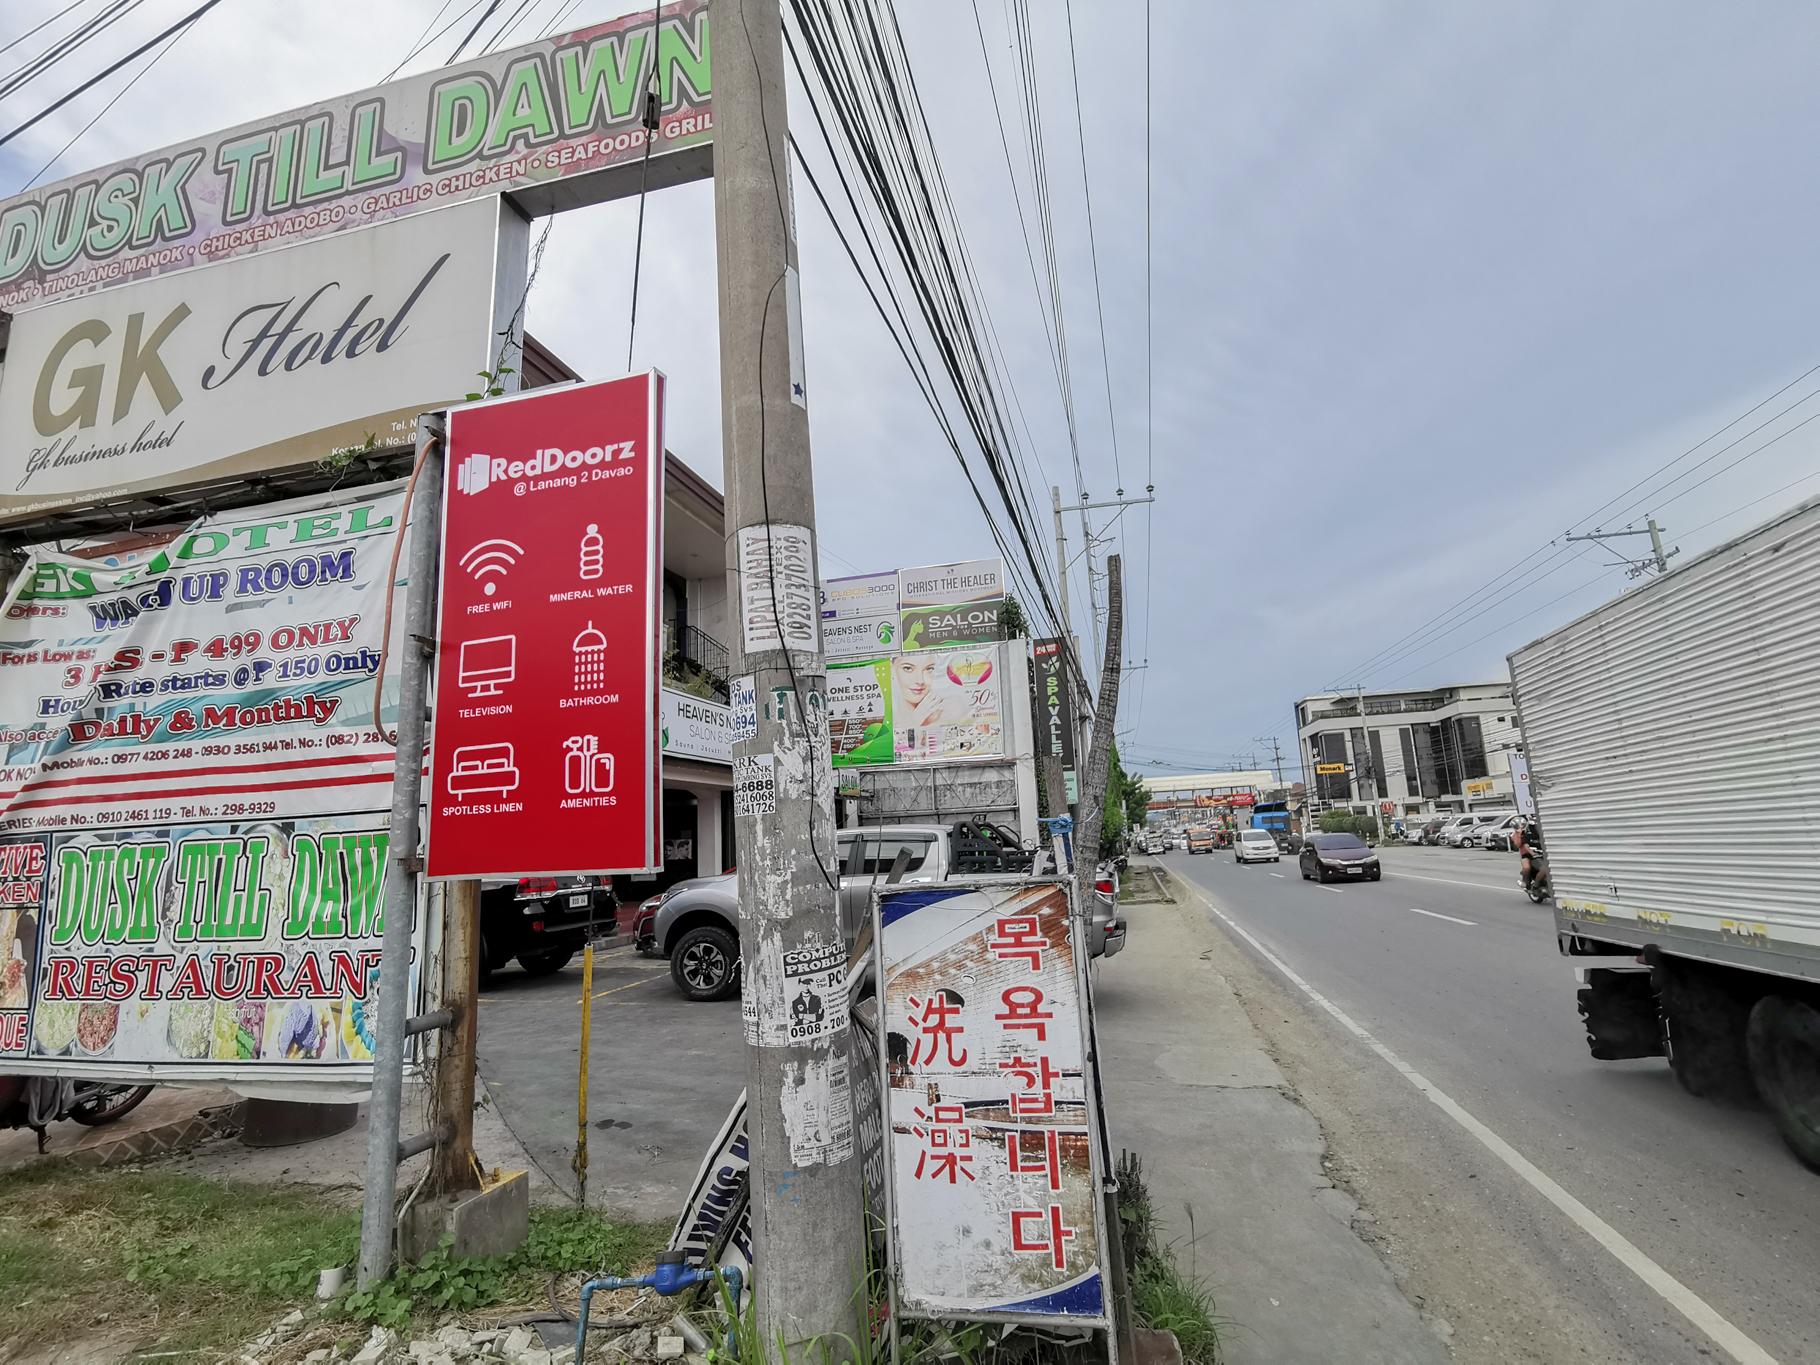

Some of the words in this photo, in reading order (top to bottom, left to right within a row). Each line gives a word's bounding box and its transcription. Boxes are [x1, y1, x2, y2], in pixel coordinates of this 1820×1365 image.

[1, 152, 199, 275] DUSK
[218, 101, 400, 220] TILL
[431, 12, 711, 165] DAWN
[42, 263, 120, 296] TINOLANG
[123, 246, 185, 275] MANOK
[199, 223, 278, 256] CHICKEN
[281, 205, 345, 236] ADOBO
[362, 183, 433, 214] GARLIC
[436, 159, 527, 197] CHICKEN
[546, 130, 659, 168] SEAFOODS
[665, 114, 713, 138] GRIL
[32, 302, 193, 438] GK
[201, 253, 451, 391] Hotel
[392, 420, 407, 431] Tel.
[386, 436, 404, 446] No.:
[16, 436, 53, 491] Gk
[53, 432, 127, 470] business
[130, 420, 184, 461] hotel
[491, 440, 636, 482] RedDoorz
[514, 482, 527, 496] @
[530, 475, 577, 491] Lanang
[581, 472, 588, 483] 2
[592, 466, 633, 481] Davao
[746, 536, 775, 592] BAHAY
[775, 536, 784, 578] TEXT
[180, 571, 229, 604] UP
[236, 549, 356, 596] ROOM
[907, 580, 939, 594] CHRIST
[940, 577, 958, 590] THE
[961, 573, 996, 588] HEALER
[550, 589, 594, 602] MINERAL
[596, 584, 633, 597] WATER
[467, 604, 490, 614] FREE
[493, 601, 512, 611] WIFI
[748, 594, 778, 641] LIPAT
[777, 595, 786, 638] CALL
[929, 610, 997, 628] SALON
[823, 625, 852, 637] EAVEN'S
[854, 624, 872, 634] NEST
[852, 635, 863, 643] SPA
[963, 626, 998, 635] WOMEN
[63, 664, 83, 688] 3
[270, 614, 360, 651] ONLY
[158, 671, 226, 694] starts
[277, 656, 319, 681] 150
[324, 649, 382, 681] Only
[560, 694, 619, 708] BATHROOM
[734, 690, 754, 708] TANK
[830, 686, 850, 695] ONE
[853, 684, 879, 693] STOP
[68, 710, 162, 744] Daily
[169, 710, 197, 736] &
[202, 696, 339, 730] Monthly
[459, 705, 512, 718] TELEVISION
[677, 701, 724, 727] HEAVEN'S
[690, 724, 715, 740] SALON
[111, 752, 139, 765] 0977
[143, 749, 170, 761] 4206
[172, 747, 192, 760] 248
[201, 744, 230, 756] 0930
[234, 743, 260, 755] 3561
[262, 740, 278, 752] 944
[279, 738, 297, 751] Tel.
[298, 736, 323, 748] No.:
[326, 733, 359, 749] (082)
[745, 765, 772, 775] TANK
[70, 812, 93, 825] No.:
[97, 811, 122, 823] 0910
[124, 809, 149, 821] 2461
[152, 807, 171, 820] 119
[180, 805, 196, 818] Tel.
[199, 805, 218, 816] No.:
[222, 801, 275, 816] 298-9329
[442, 804, 491, 816] SPOTLESS
[494, 802, 523, 813] LINEN
[560, 796, 617, 808] AMENITIES
[53, 843, 169, 944] DUSK
[175, 839, 269, 941] TILL
[284, 833, 390, 938] DAW
[828, 970, 841, 987] PC
[791, 1023, 821, 1038] 0908
[830, 1014, 844, 1029] 700
[907, 991, 977, 1185] 洗澡
[989, 914, 1076, 1271] 목욕합니다
